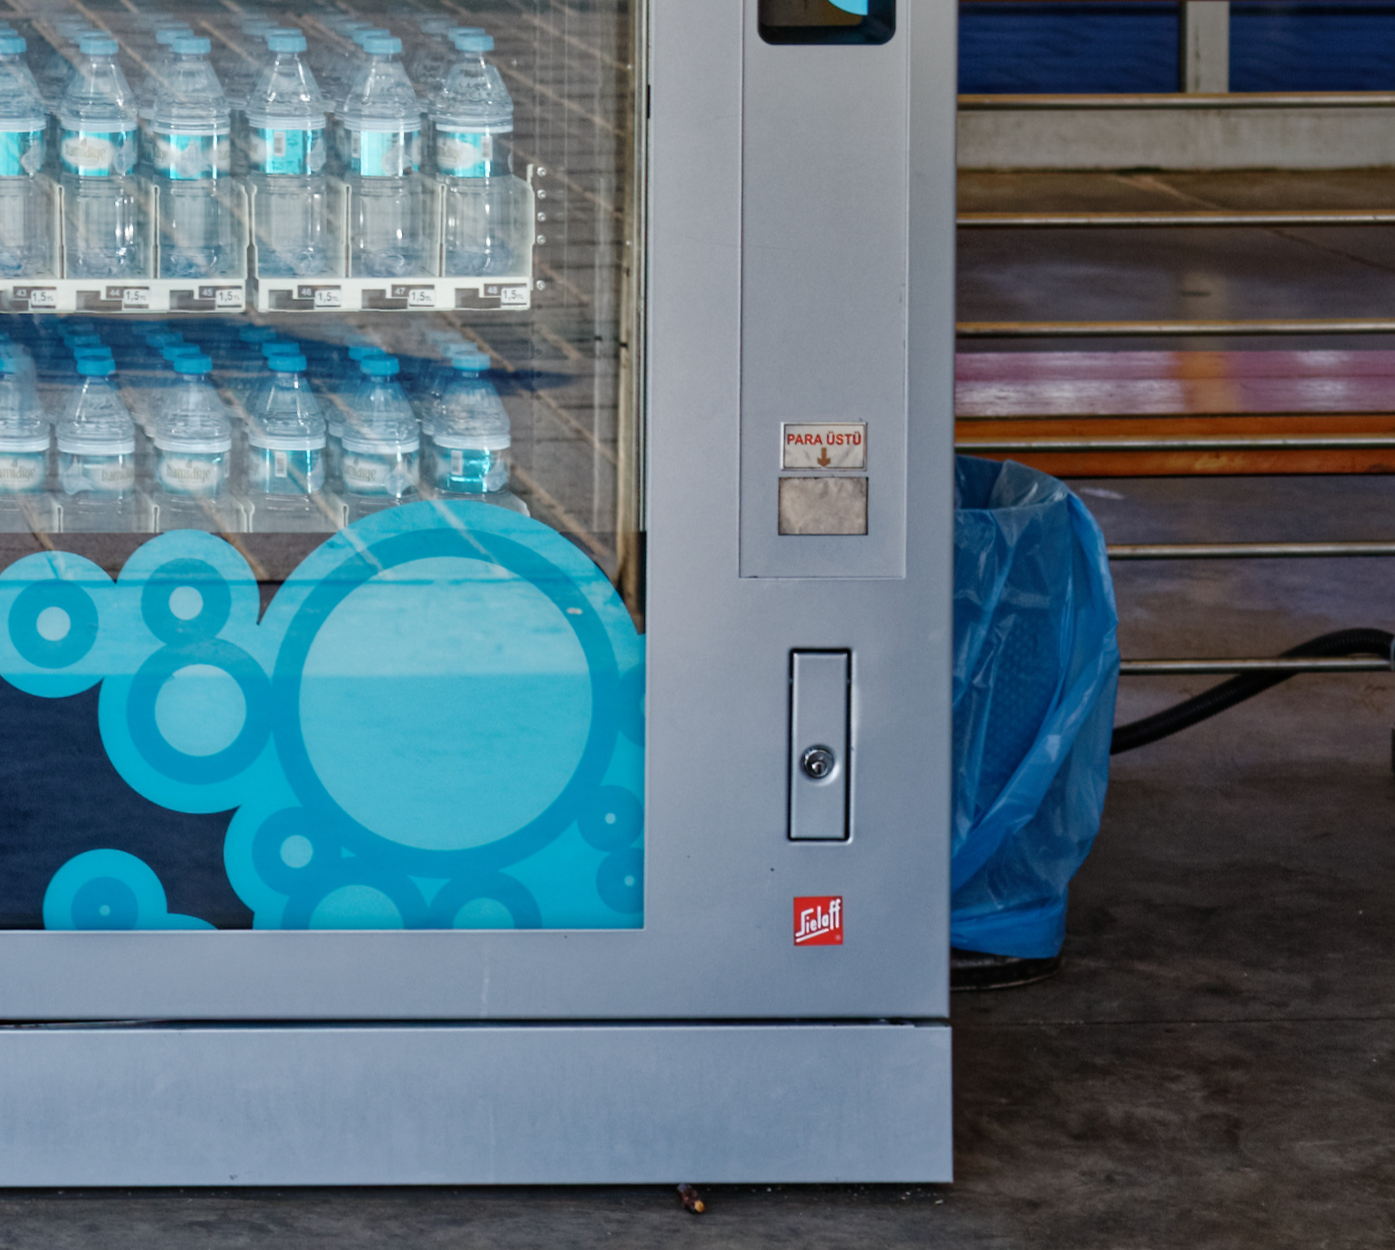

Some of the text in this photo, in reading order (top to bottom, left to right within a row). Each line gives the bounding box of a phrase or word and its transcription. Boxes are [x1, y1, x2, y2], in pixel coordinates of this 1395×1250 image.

[787, 431, 862, 445] PARA ÜSTÜ
[795, 898, 841, 937] Sielaff
